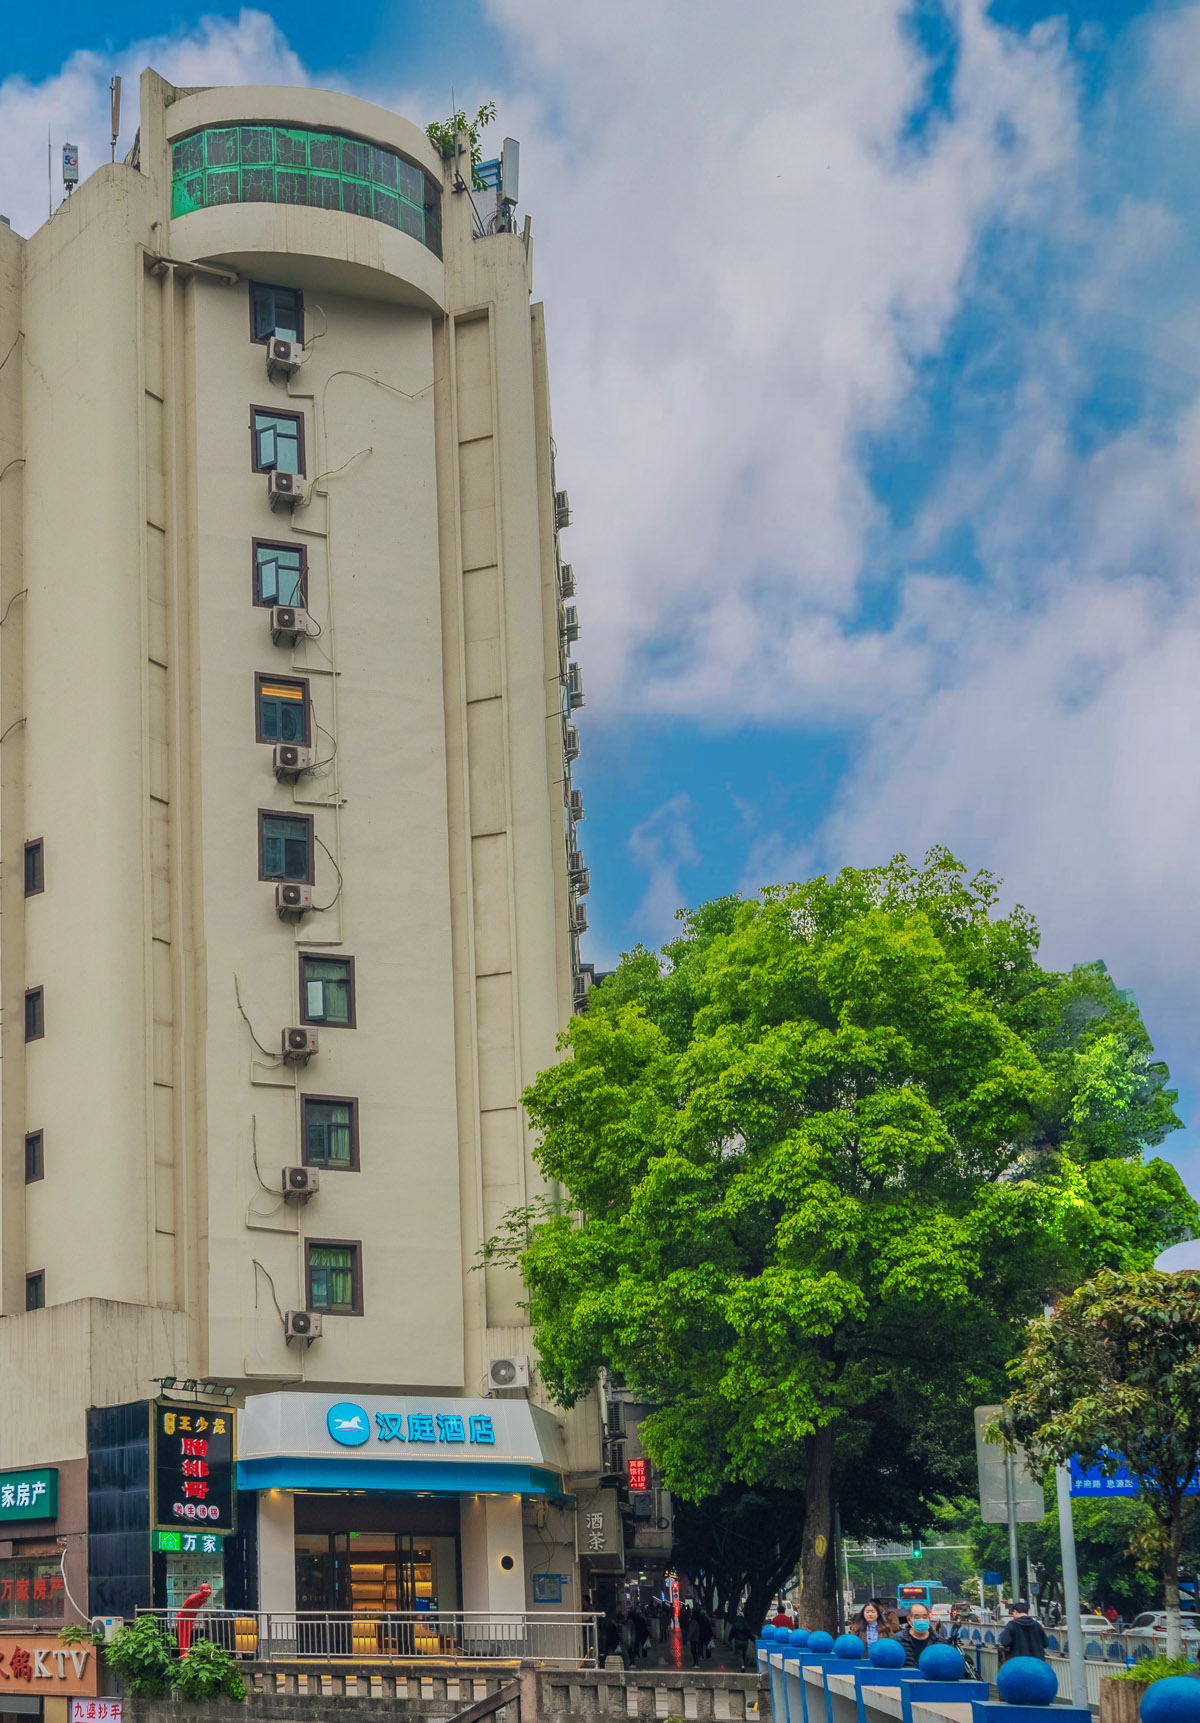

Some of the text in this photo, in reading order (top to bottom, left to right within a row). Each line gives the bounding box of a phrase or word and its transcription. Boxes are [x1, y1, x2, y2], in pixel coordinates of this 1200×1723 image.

[64, 155, 78, 167] 5G
[178, 1416, 226, 1434] 王少龙
[376, 1412, 495, 1443] 汉庭酒店
[1074, 1479, 1101, 1489] 学府路
[0, 1578, 65, 1601] 万家房产
[74, 1702, 121, 1720] 九婆抄手
